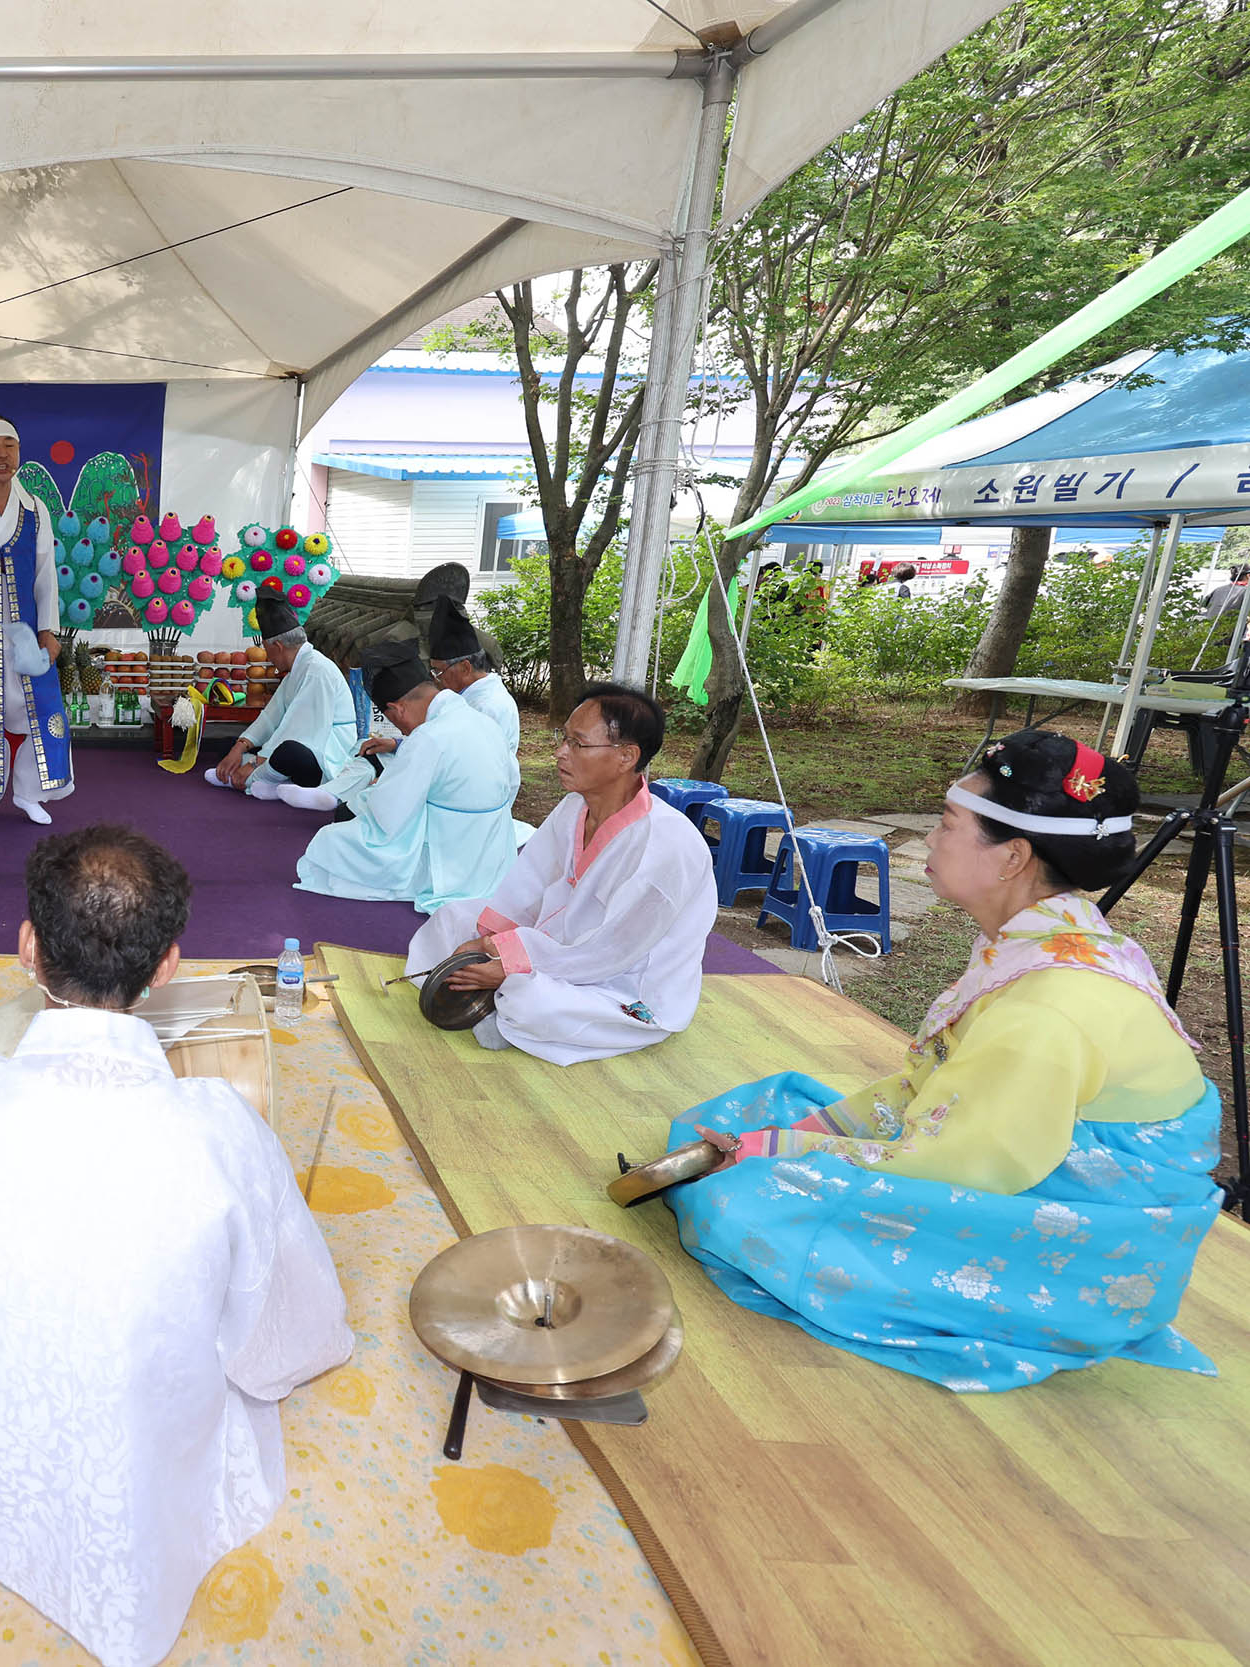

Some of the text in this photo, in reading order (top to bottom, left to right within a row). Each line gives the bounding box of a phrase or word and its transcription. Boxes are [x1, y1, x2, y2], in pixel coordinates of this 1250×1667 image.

[824, 486, 942, 508] 2023 삼척미로 단오제
[973, 468, 1136, 505] 소원빌기
[1165, 463, 1201, 499] /
